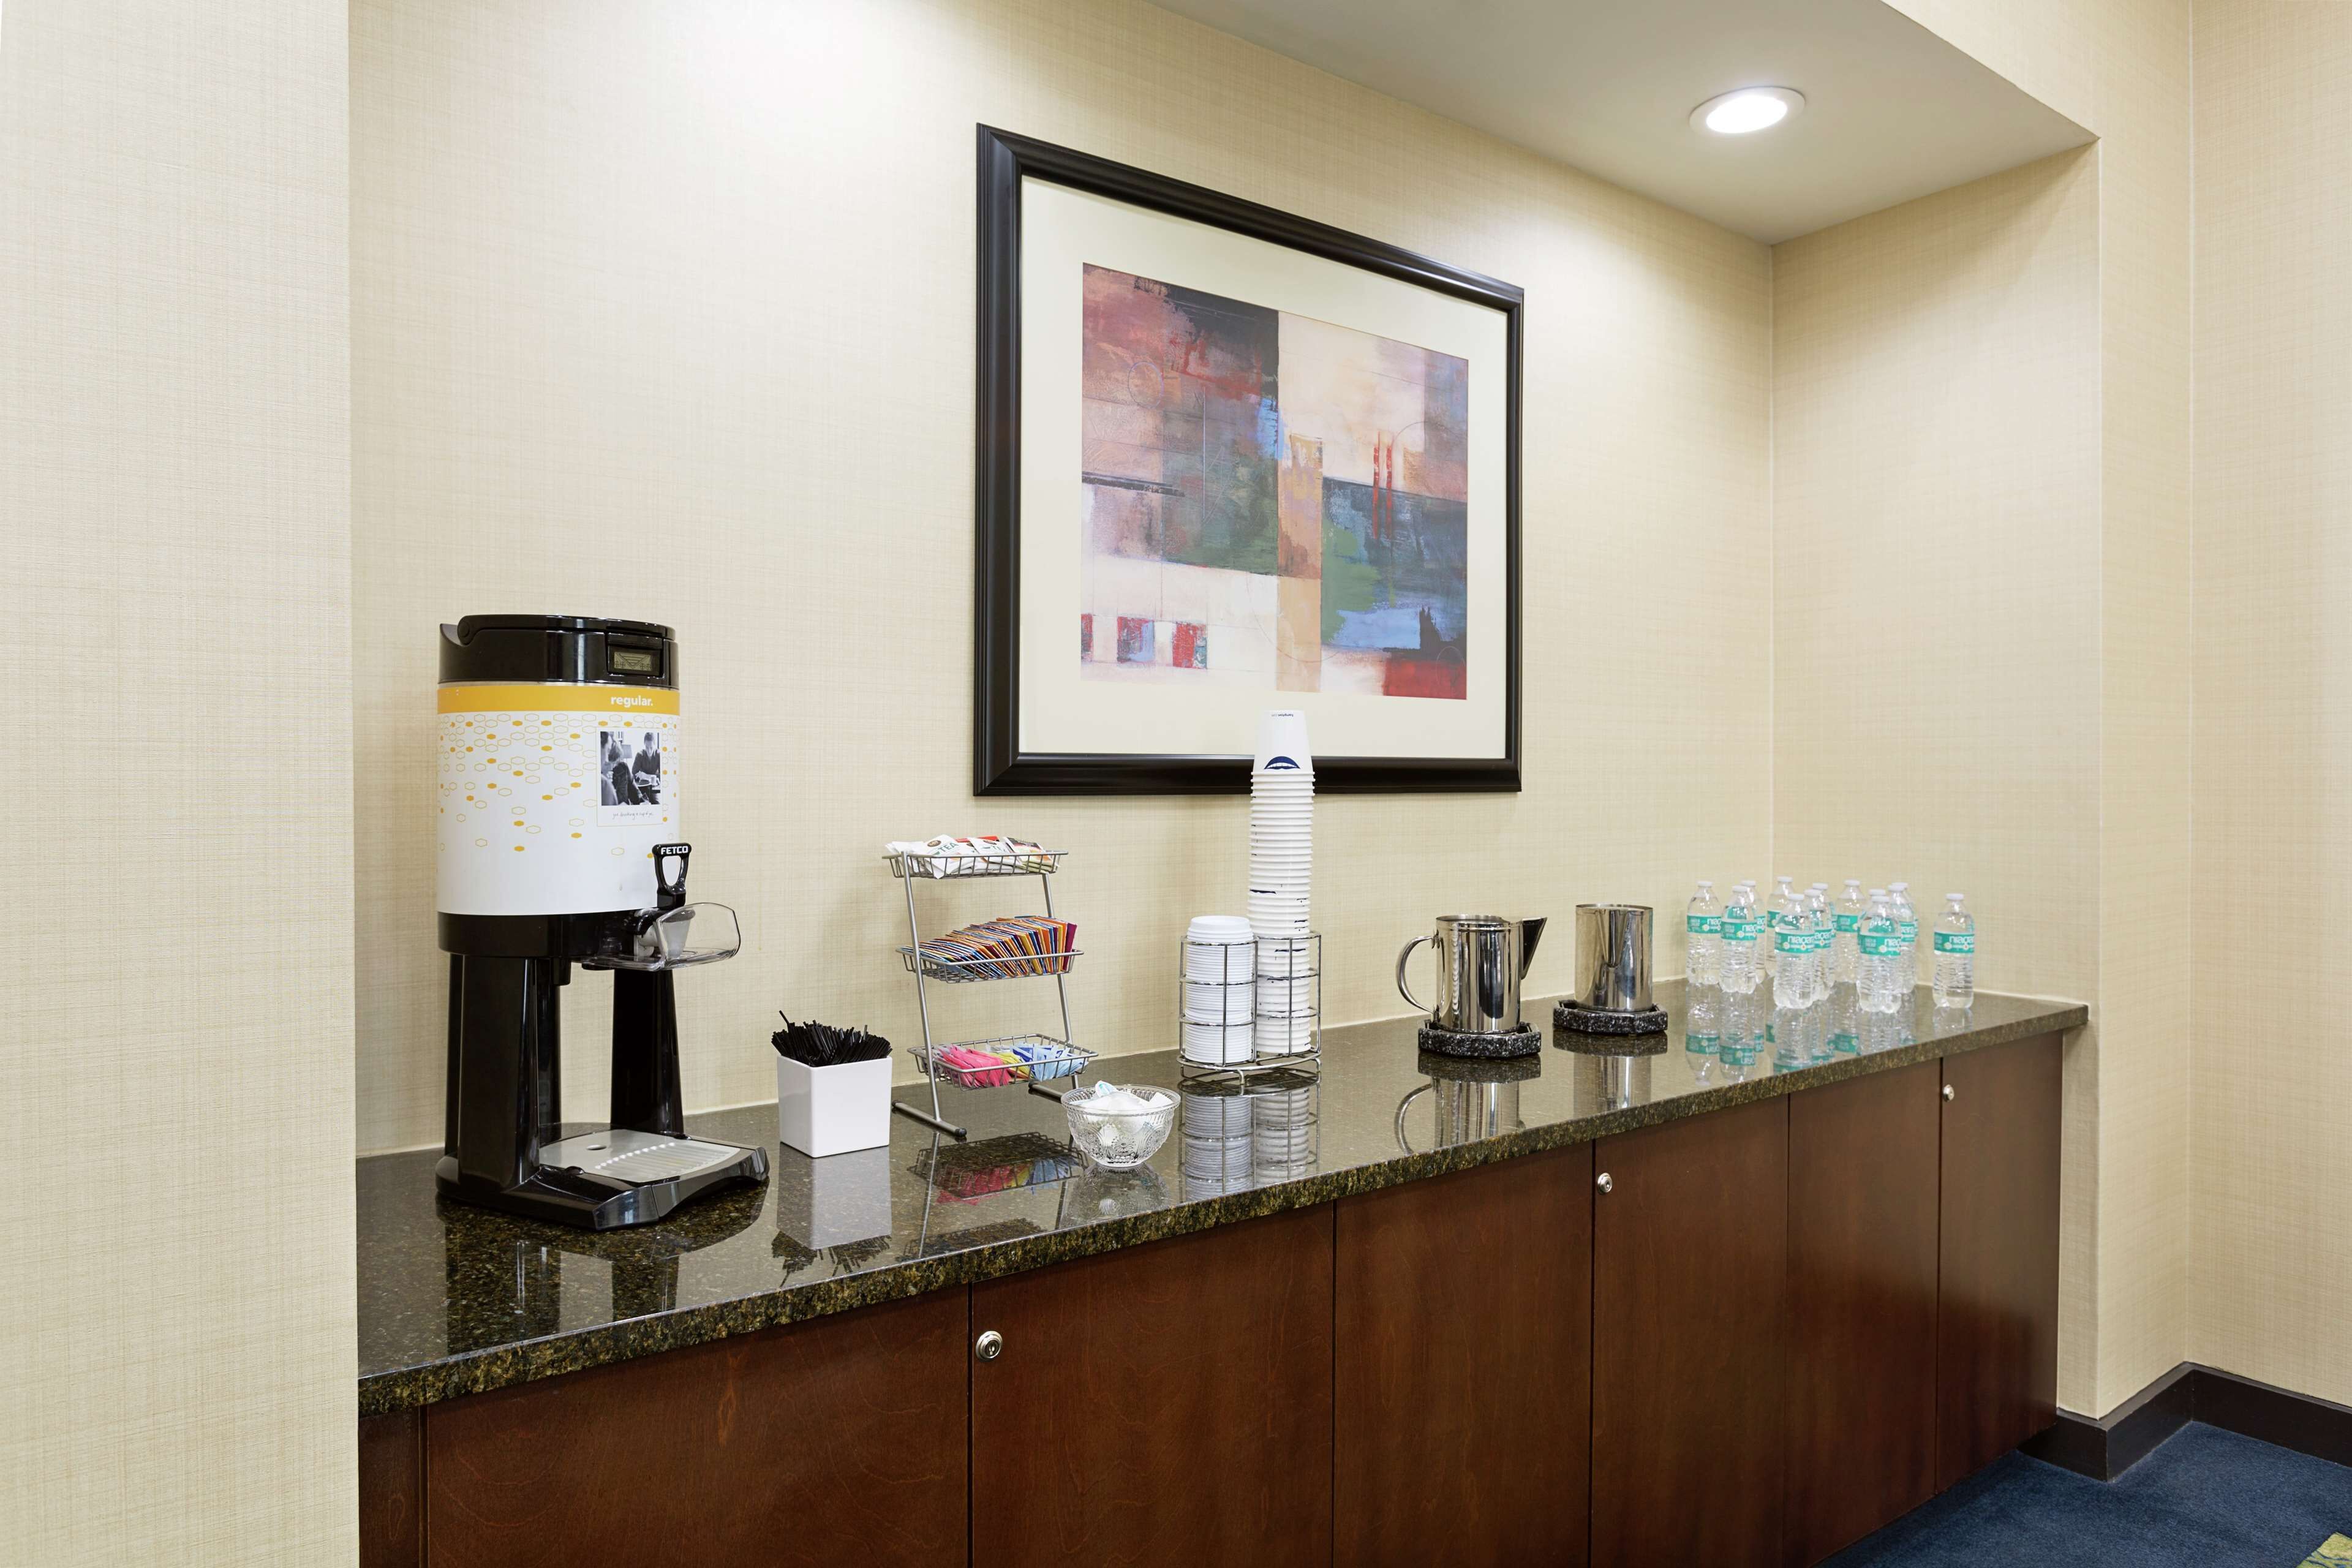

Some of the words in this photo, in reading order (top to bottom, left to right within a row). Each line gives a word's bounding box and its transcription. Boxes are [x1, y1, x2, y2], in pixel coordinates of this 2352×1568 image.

[611, 695, 653, 707] regular.
[661, 846, 688, 854] FETCO
[938, 842, 959, 852] TEA
